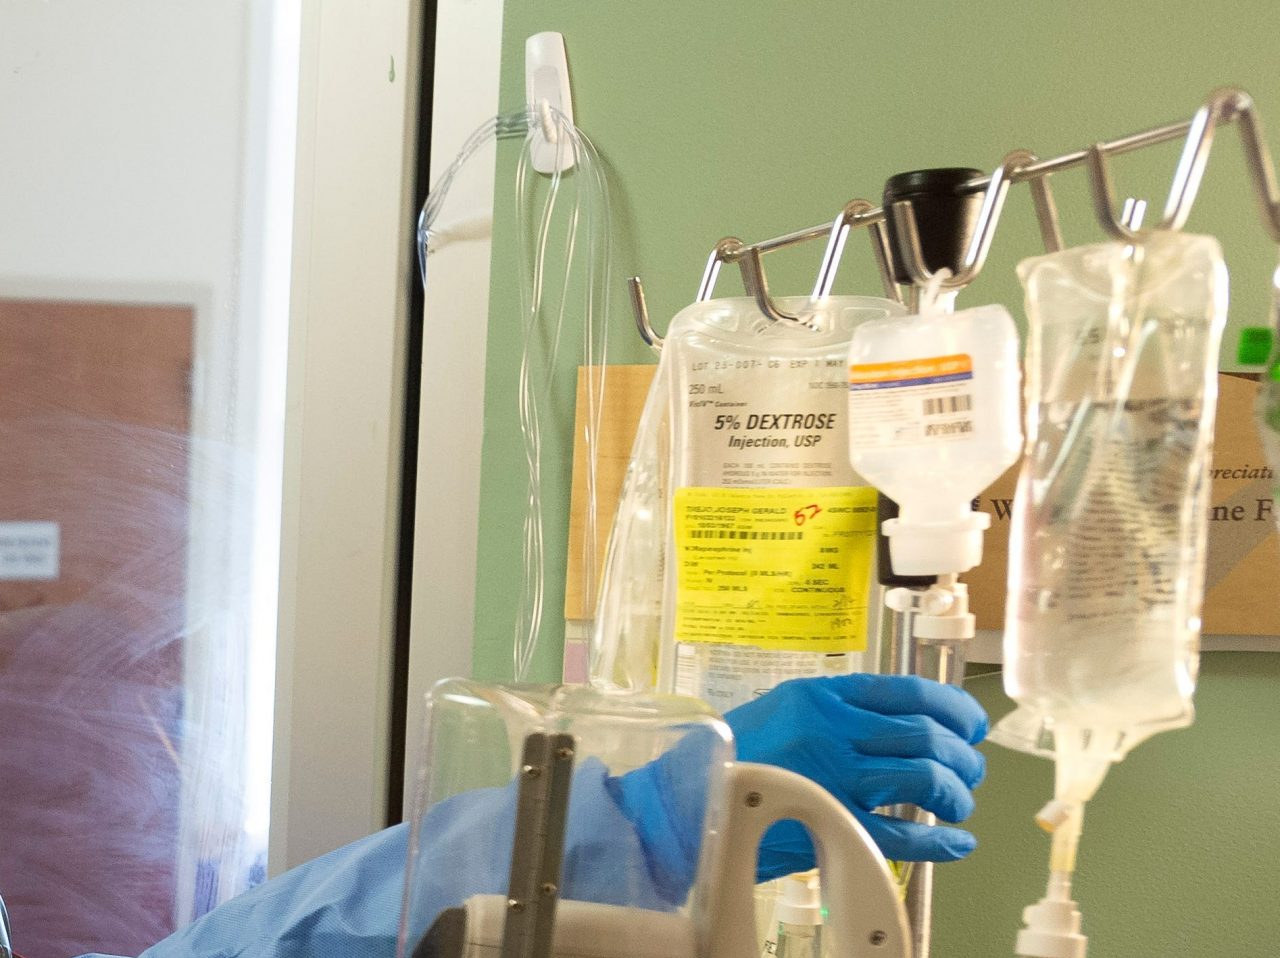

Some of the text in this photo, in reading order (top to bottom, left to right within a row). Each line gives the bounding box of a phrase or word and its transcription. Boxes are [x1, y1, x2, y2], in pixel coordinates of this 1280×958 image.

[688, 383, 705, 395] 250
[714, 413, 837, 431] 5% DEXTROSE
[728, 434, 822, 451] Injection, USP
